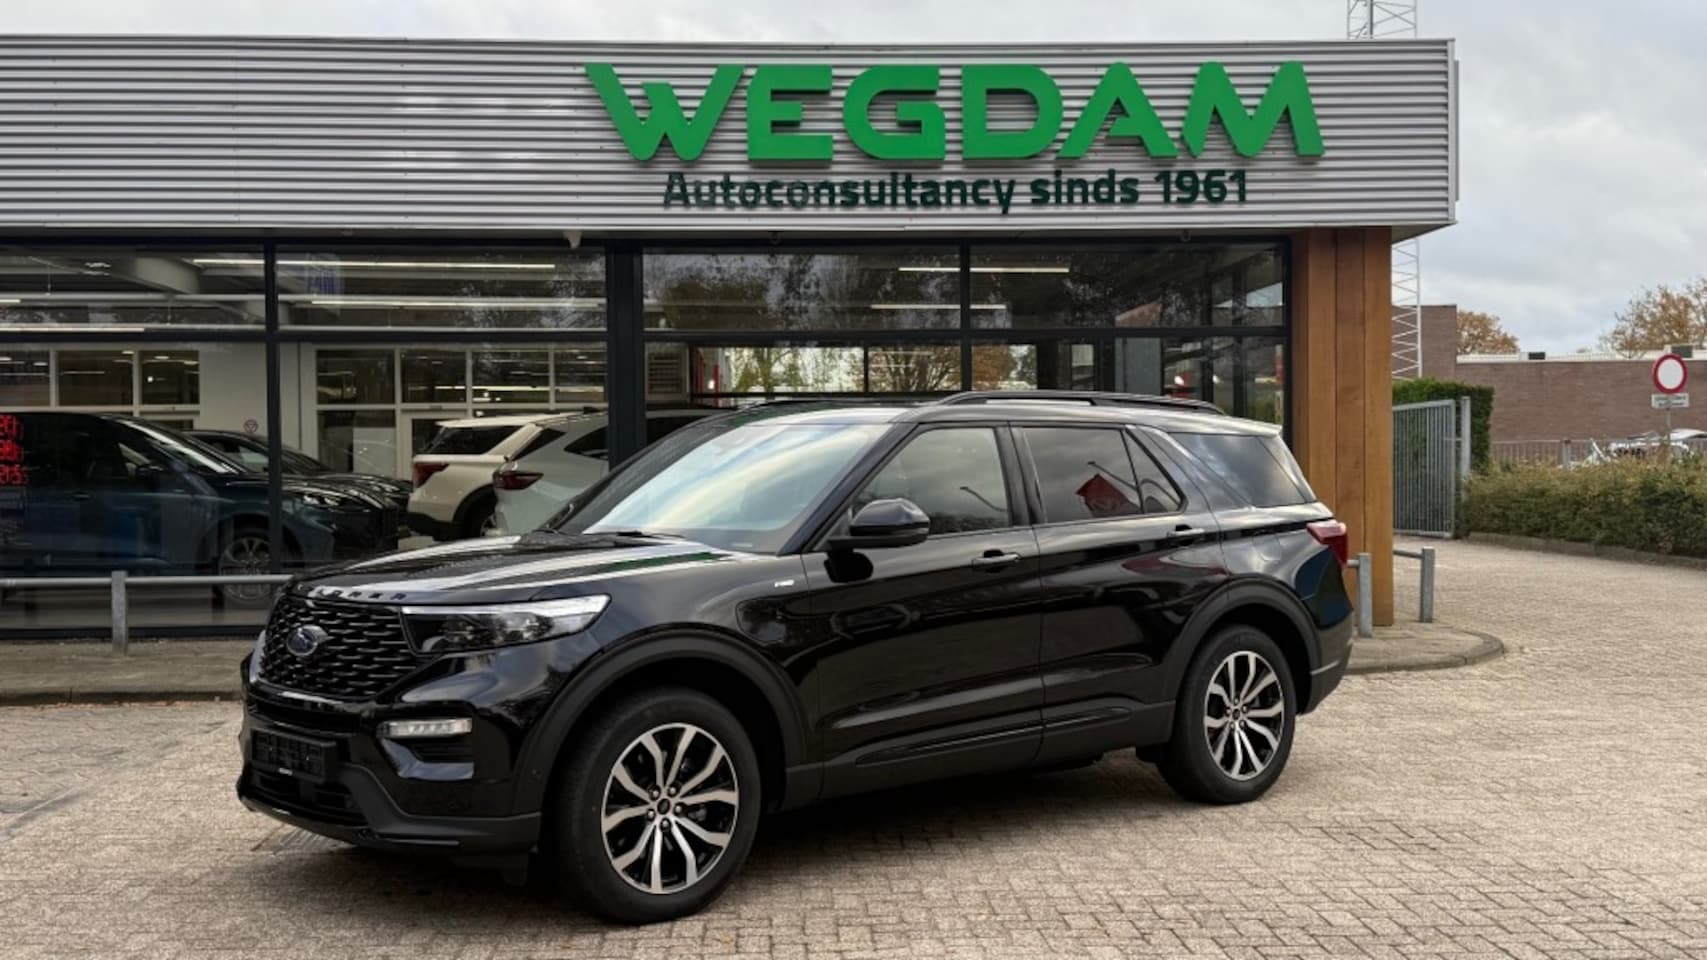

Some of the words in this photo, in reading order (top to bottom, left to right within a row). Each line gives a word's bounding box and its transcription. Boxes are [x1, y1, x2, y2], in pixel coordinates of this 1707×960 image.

[584, 61, 1325, 162] WEGDAM
[663, 171, 1015, 215] Autoconsultancy
[1030, 168, 1139, 206] sinds
[1154, 168, 1247, 204] 1961
